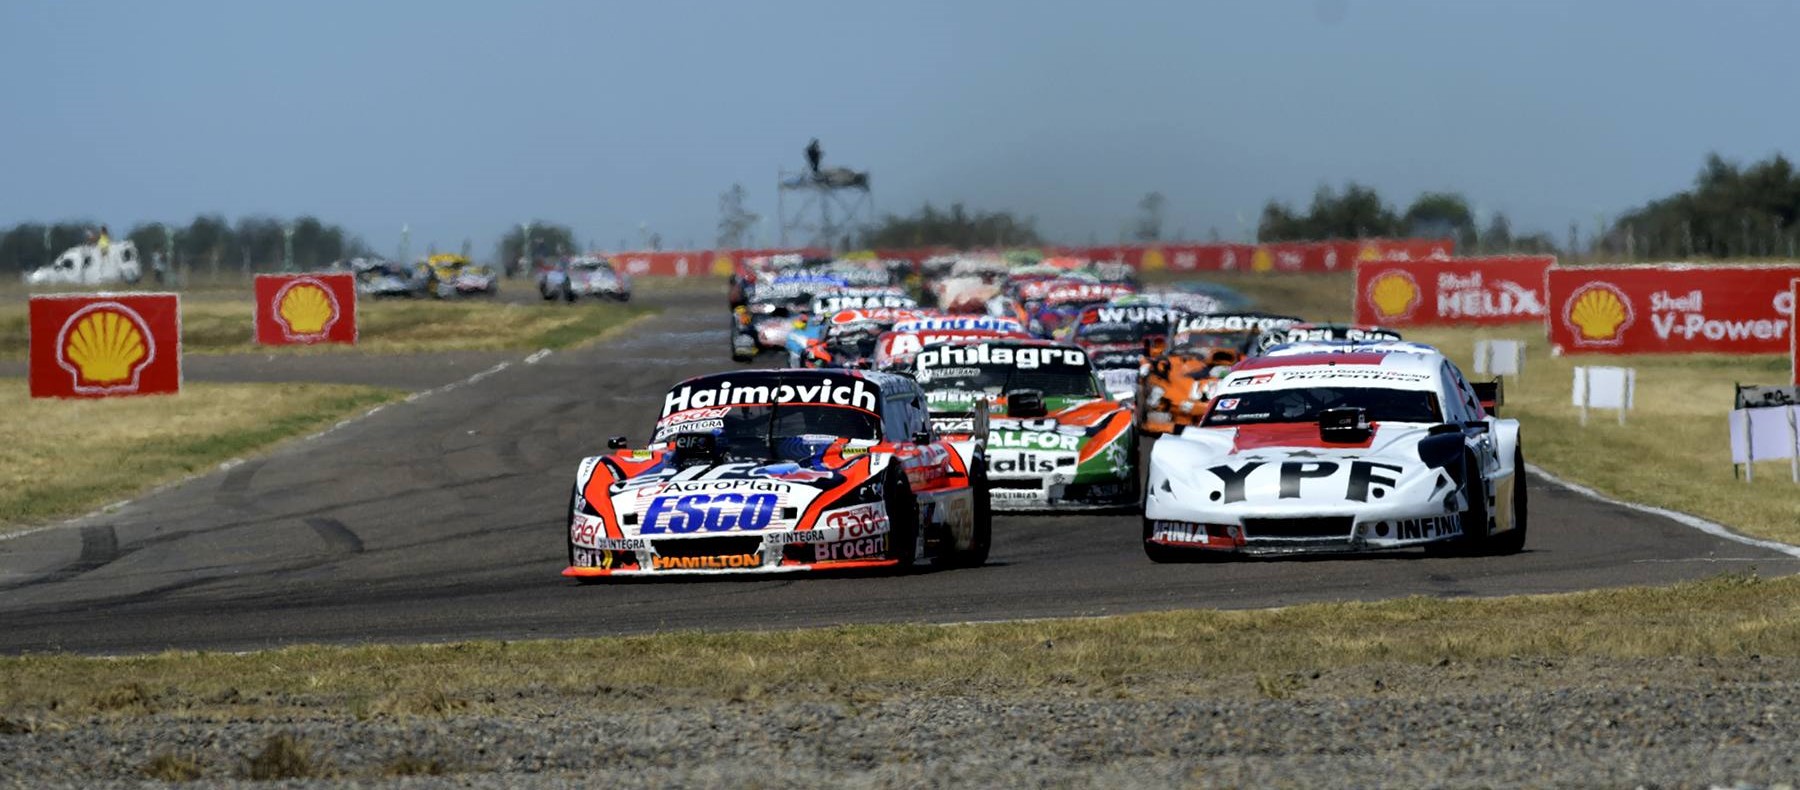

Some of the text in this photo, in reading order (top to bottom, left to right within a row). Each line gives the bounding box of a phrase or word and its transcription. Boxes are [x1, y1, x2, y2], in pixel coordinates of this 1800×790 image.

[1437, 280, 1546, 317] HELIX
[1650, 290, 1702, 311] Shell
[1098, 307, 1179, 323] WURT
[1651, 311, 1788, 340] V-Power
[917, 344, 1085, 369] philagro
[662, 379, 876, 418] Haimovich
[1208, 460, 1403, 504] YPF
[640, 493, 779, 534] ESCO
[782, 529, 825, 543] INTEGRA
[1397, 514, 1463, 540] INFINI
[652, 554, 761, 569] HAMILTON
